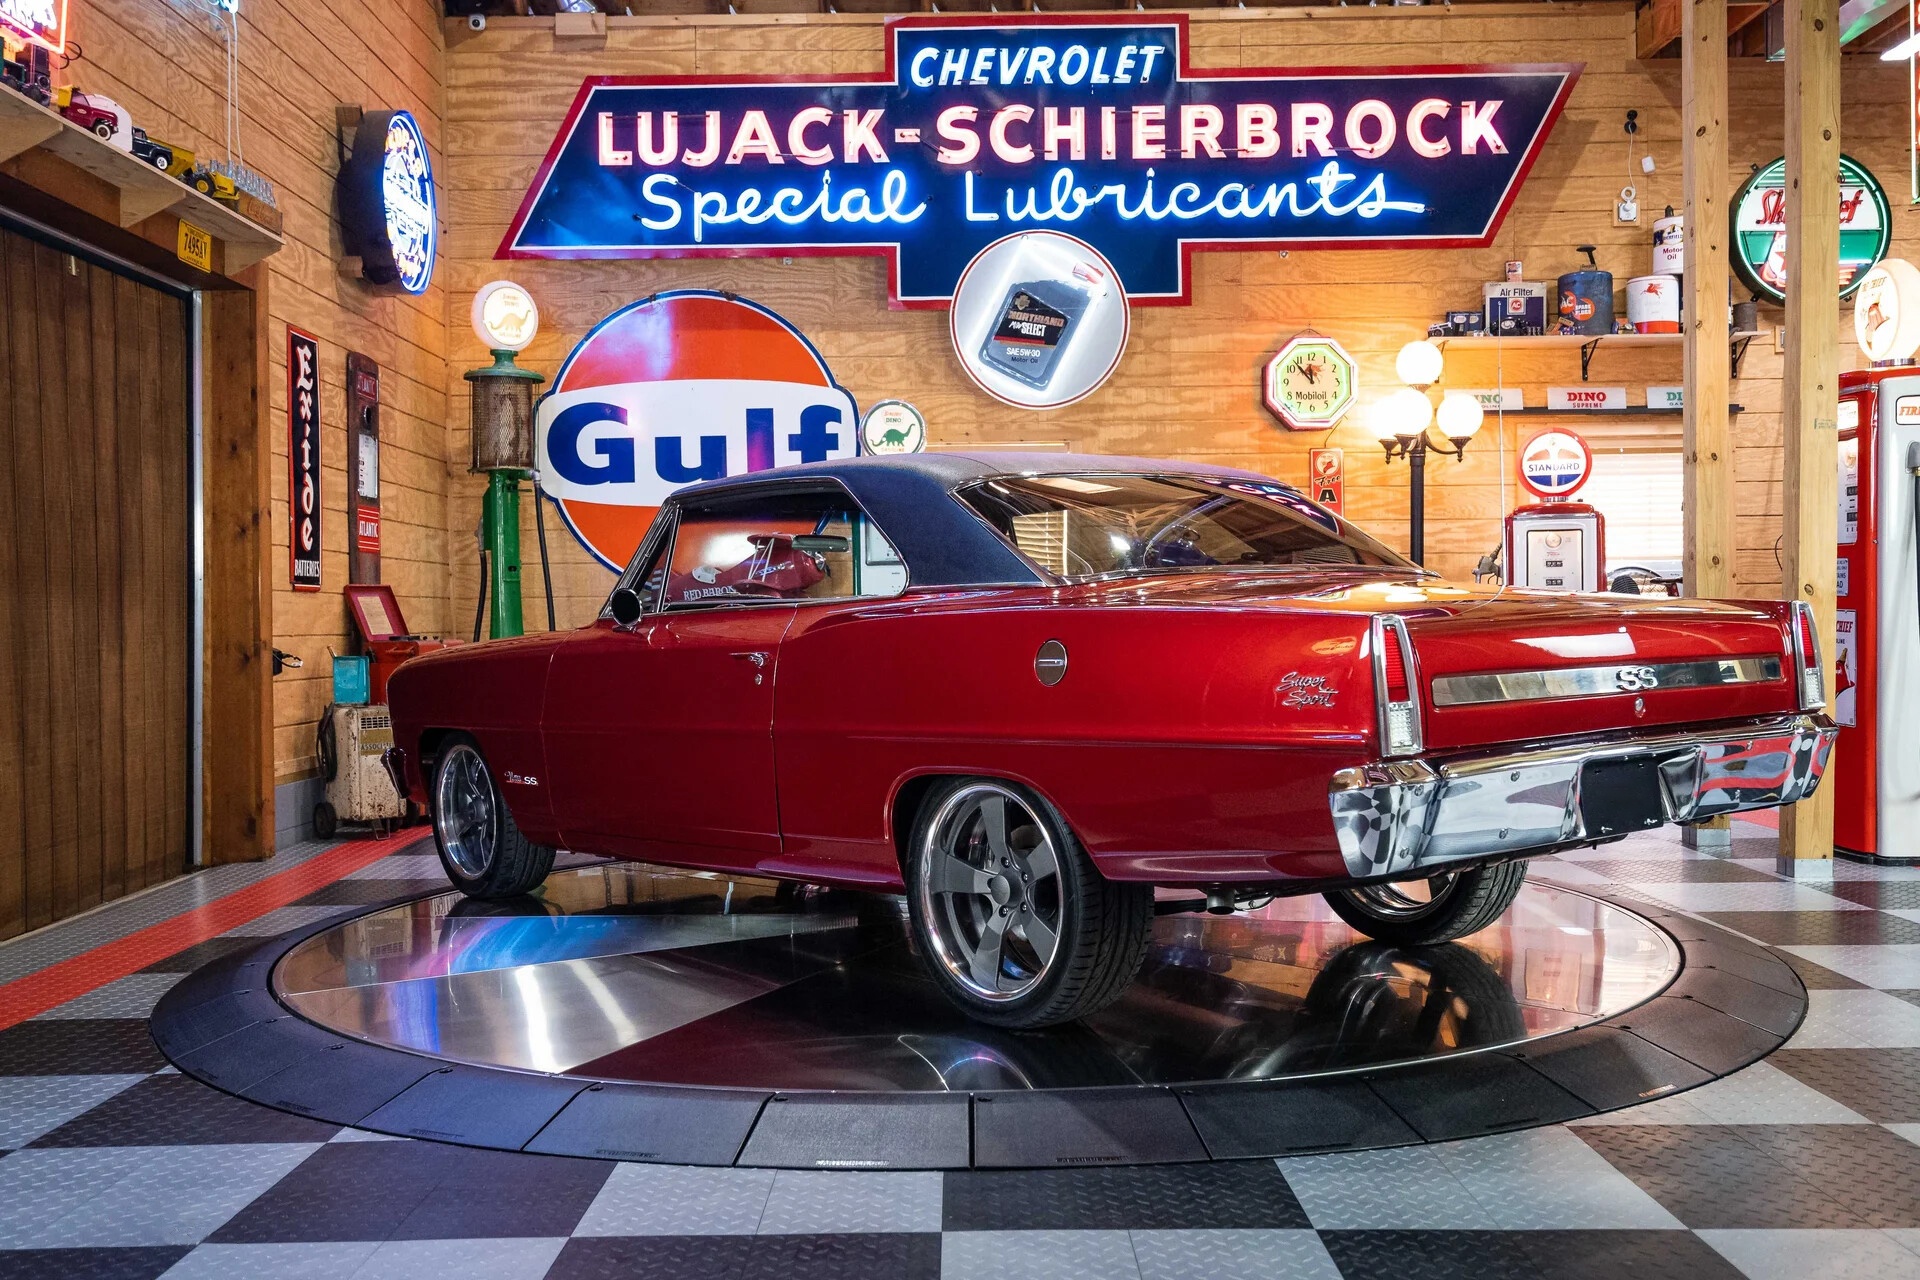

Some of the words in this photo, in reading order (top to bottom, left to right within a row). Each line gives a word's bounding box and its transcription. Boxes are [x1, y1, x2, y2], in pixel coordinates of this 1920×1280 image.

[910, 44, 1165, 87] CHEVROLET
[639, 169, 927, 242] Special
[965, 160, 1426, 221] Lubricants
[1500, 288, 1511, 296] Air
[1514, 288, 1533, 296] Filter
[1512, 302, 1521, 310] AC
[1561, 296, 1574, 309] AC
[1008, 310, 1065, 328] NORTHLAND
[1006, 347, 1020, 356] SAE
[1020, 348, 1041, 357] 5W-30
[1307, 353, 1315, 361] 12
[1286, 365, 1296, 373] 10
[1331, 364, 1337, 372] 2
[1283, 378, 1289, 386] 9
[1335, 378, 1340, 386] 3
[1286, 391, 1292, 400] 8
[1295, 391, 1327, 400] Mobiloil
[1331, 391, 1337, 399] 4
[1566, 391, 1607, 401] DINO
[1666, 391, 1683, 401] DI
[1297, 402, 1302, 410] 7
[1309, 403, 1315, 412] 6
[1324, 401, 1329, 409] 5
[296, 343, 315, 551] Exide
[547, 402, 843, 486] Gulf
[1528, 462, 1580, 472] STANDARD
[1314, 475, 1341, 486] Free
[359, 520, 379, 538] ATLANTIC
[295, 559, 320, 577] BATTERIES
[683, 589, 702, 601] RED
[1276, 671, 1333, 692] Super
[1616, 665, 1659, 691] SS
[1282, 689, 1339, 711] Sport
[523, 776, 538, 786] SS
